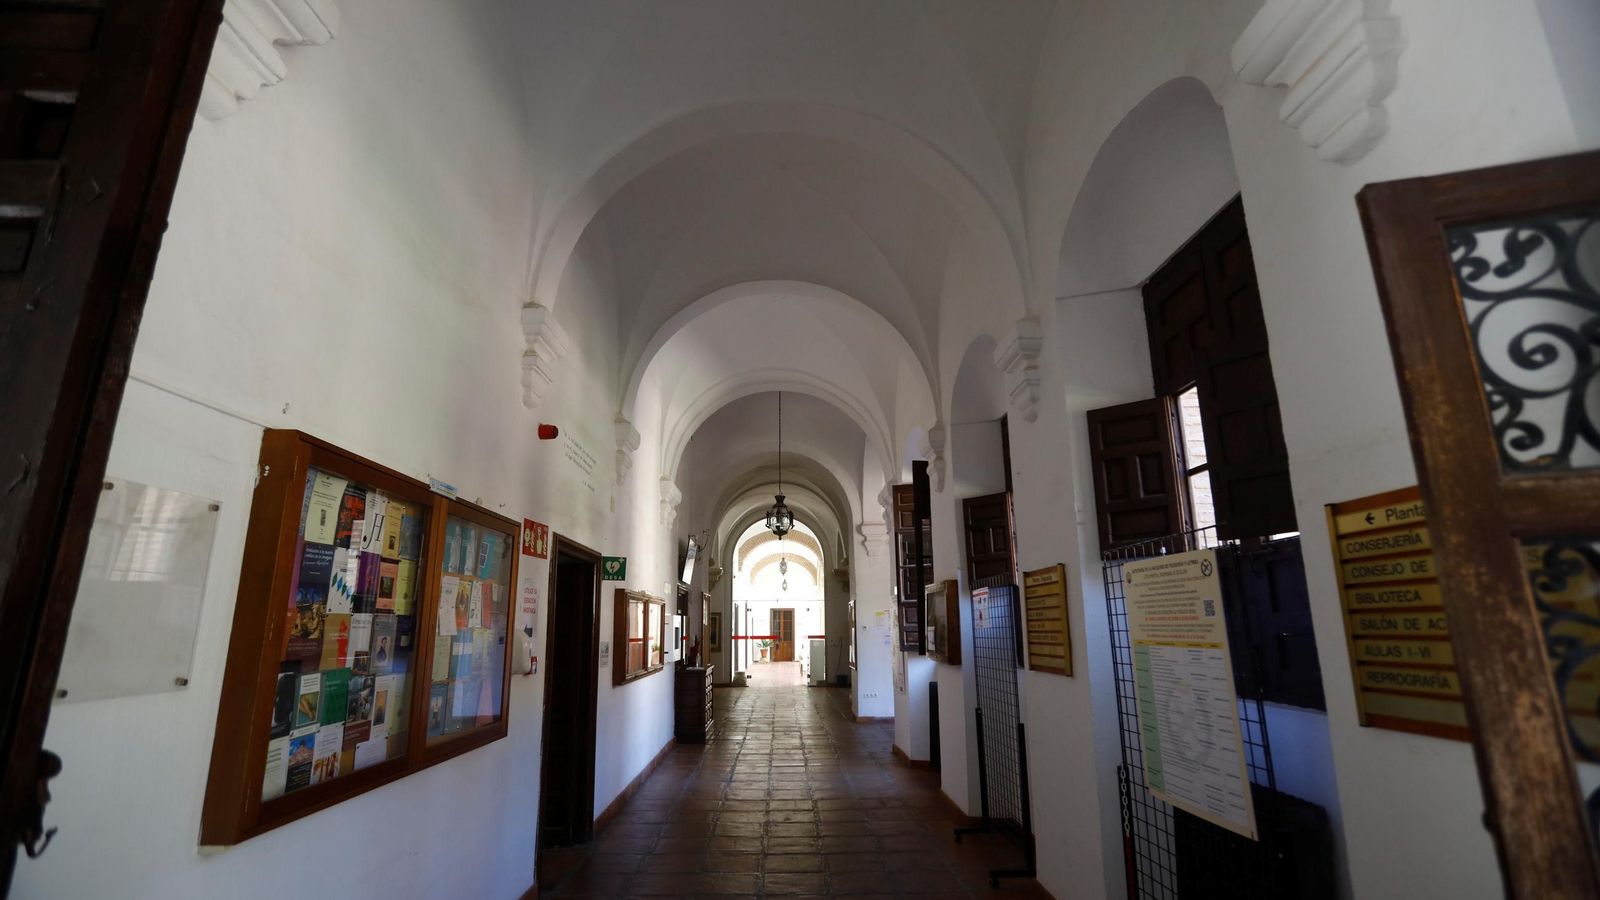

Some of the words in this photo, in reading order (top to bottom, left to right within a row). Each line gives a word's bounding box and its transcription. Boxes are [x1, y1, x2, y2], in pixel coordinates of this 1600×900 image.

[1346, 529, 1423, 554] CONSERJERÍA
[1351, 562, 1405, 578] CONSEJO
[1410, 560, 1428, 574] DE
[1355, 590, 1423, 604] BIBLIOTECA
[1360, 614, 1398, 631] SALÓN
[1403, 618, 1421, 630] DE
[1364, 644, 1402, 657] AULAS
[1367, 671, 1453, 690] REPROGRAFÍA
